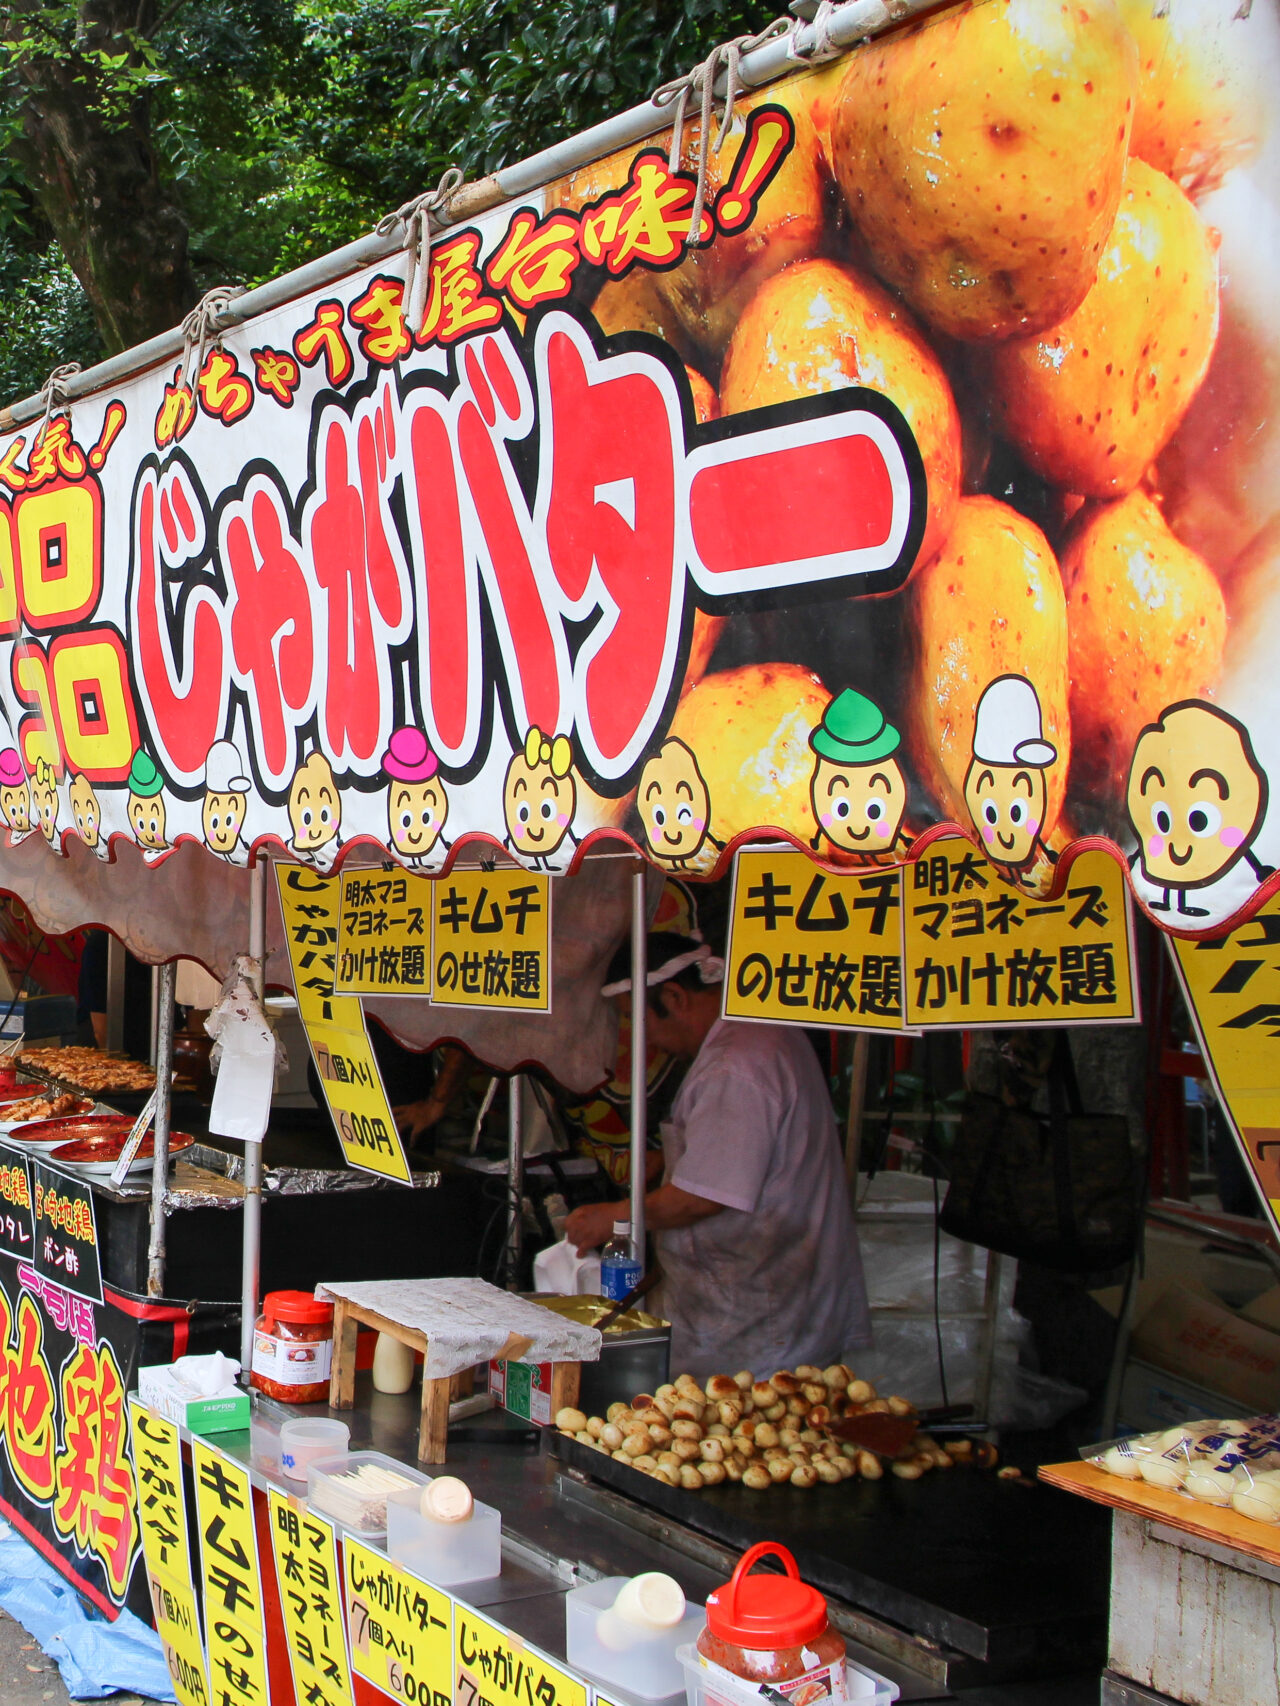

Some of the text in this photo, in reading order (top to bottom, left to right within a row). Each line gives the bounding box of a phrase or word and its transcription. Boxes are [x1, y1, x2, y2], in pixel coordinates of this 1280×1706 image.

[131, 309, 910, 787] じゃがバター
[343, 907, 425, 937] マヨネーズ
[345, 878, 408, 908] 明太マヨ
[439, 885, 541, 936] キムチ
[743, 872, 900, 936] キムチ
[912, 884, 1110, 941] マヨネーズ
[339, 945, 425, 985] かけ放題
[436, 950, 541, 1000] のせ放題
[736, 951, 902, 1018] のせ放題
[914, 942, 1118, 1010] かけ放題
[317, 1050, 375, 1089] 7個入り
[339, 1111, 395, 1157] 600円
[43, 1235, 80, 1277] ポン酢
[137, 1415, 180, 1566] じゃがバター
[152, 1579, 194, 1637] 7個入り
[302, 1521, 344, 1689] マヨネーズ
[351, 1552, 447, 1632] じゃがバター
[351, 1600, 414, 1666] 7個入り
[168, 1646, 206, 1706] 600円
[460, 1621, 562, 1706] じゃがバタ
